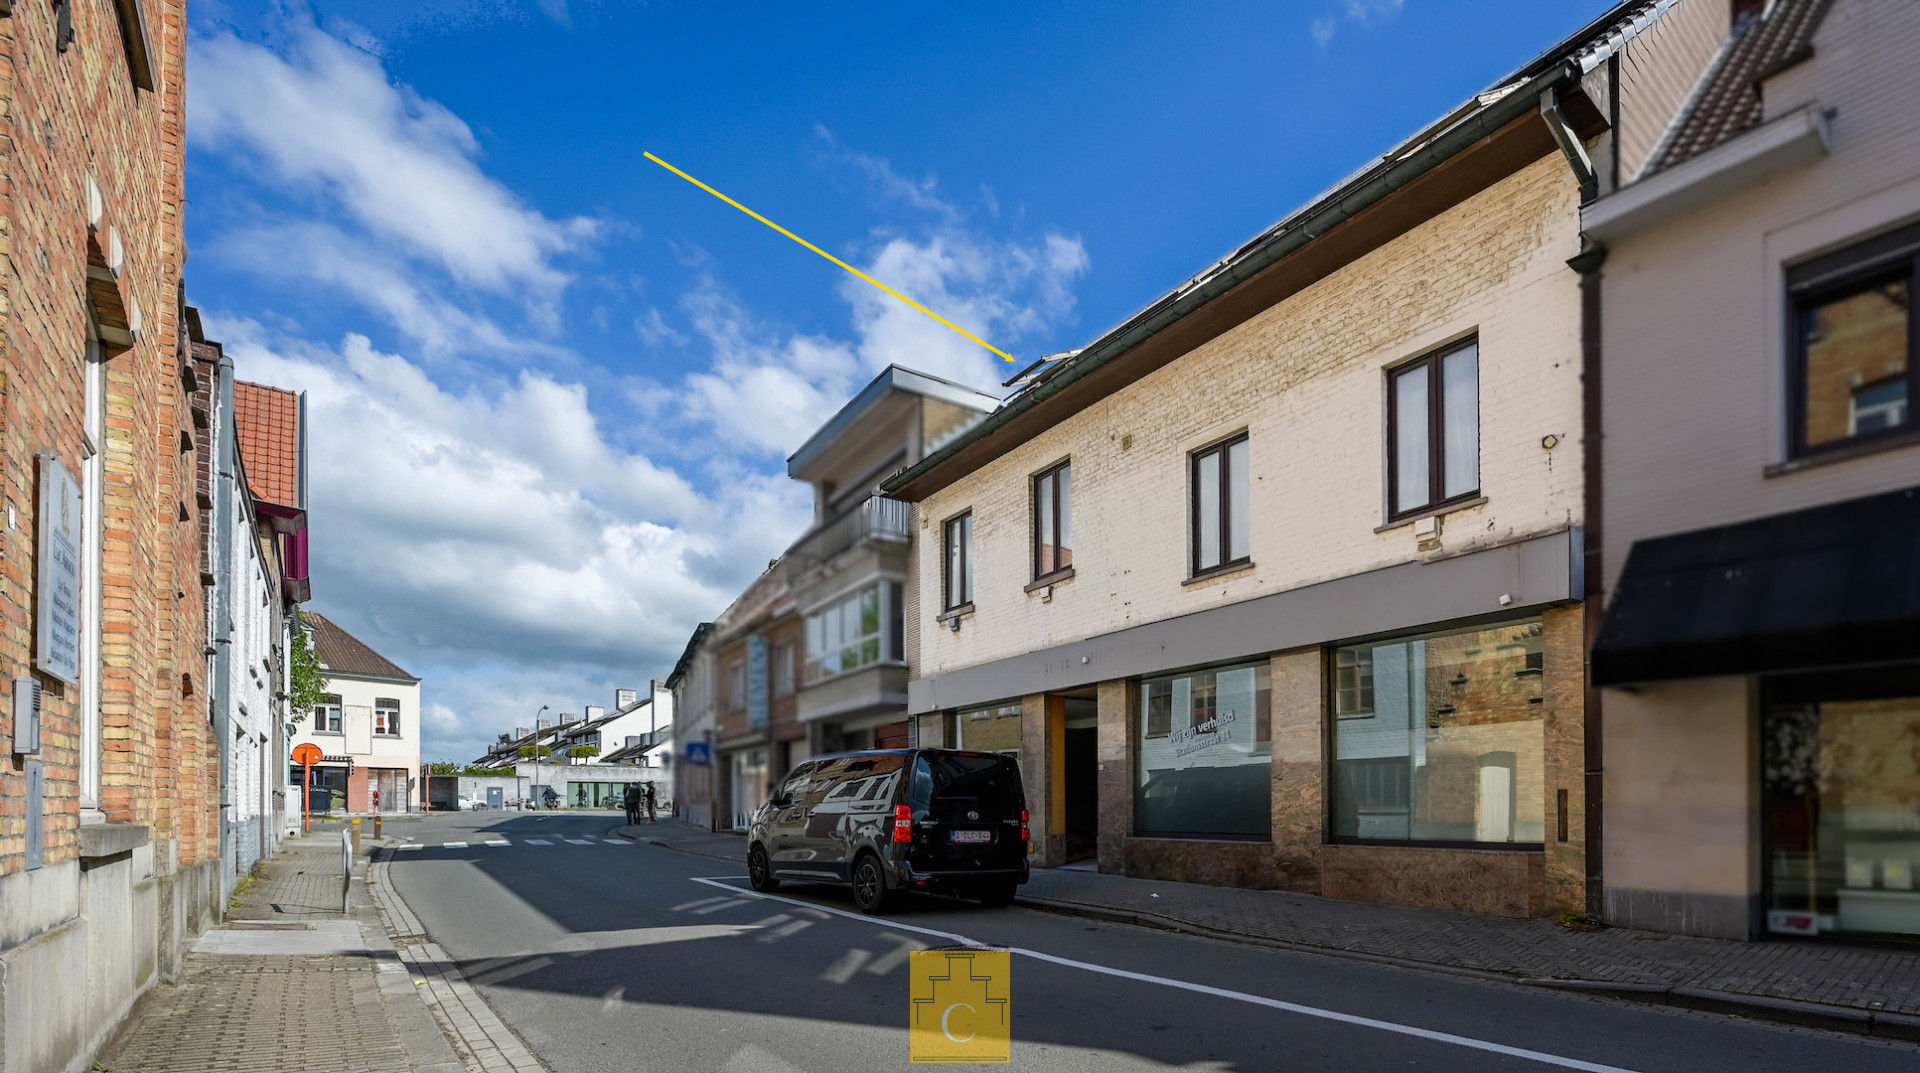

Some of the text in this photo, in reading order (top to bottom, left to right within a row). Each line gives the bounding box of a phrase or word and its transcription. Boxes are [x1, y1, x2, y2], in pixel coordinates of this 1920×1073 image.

[1167, 709, 1236, 743] Wij zijn verhuisd
